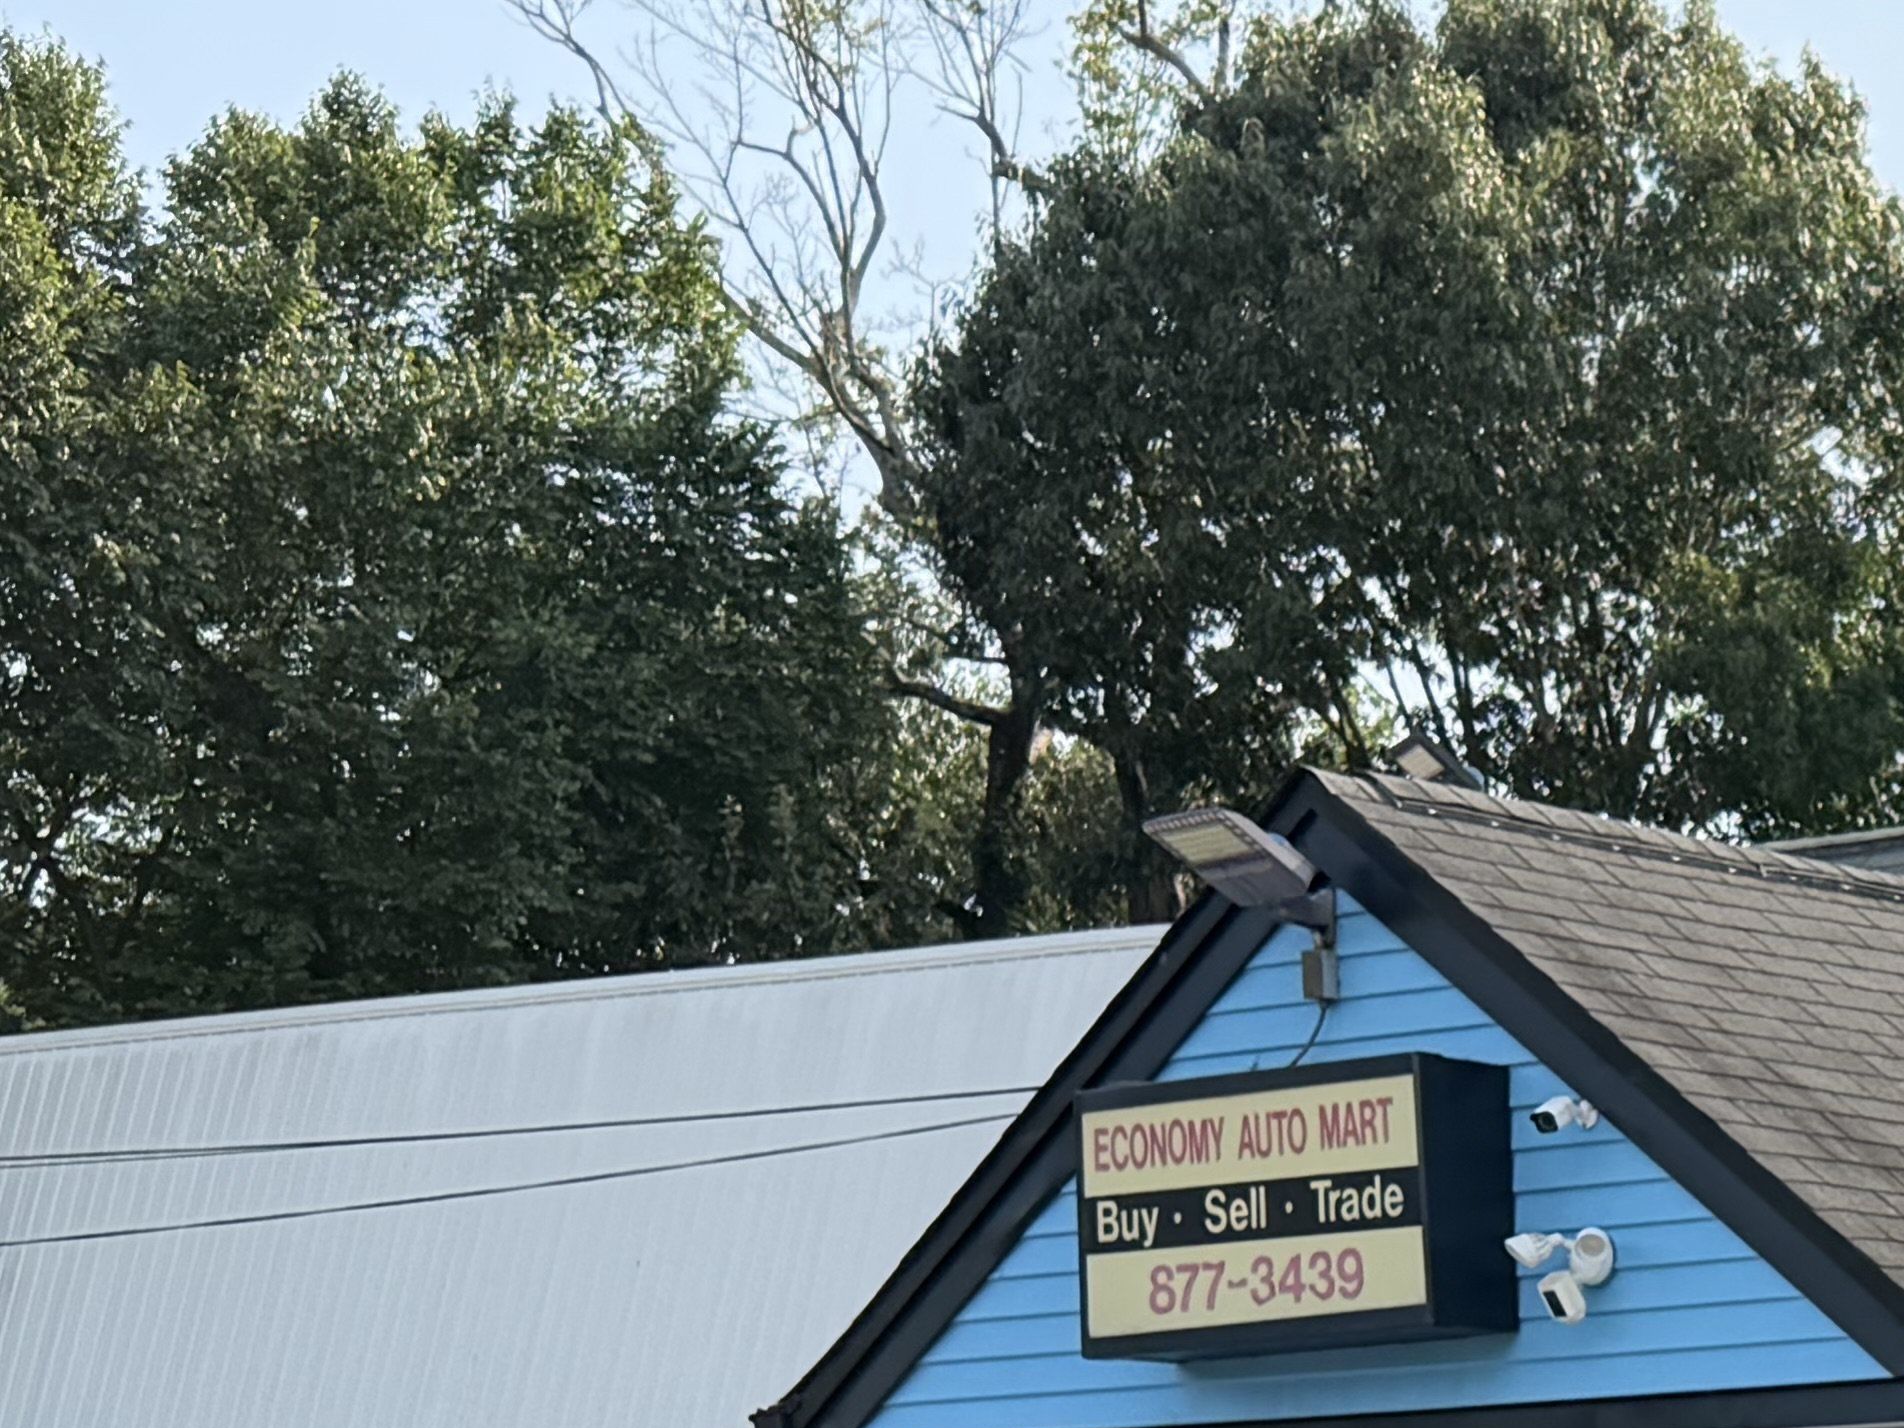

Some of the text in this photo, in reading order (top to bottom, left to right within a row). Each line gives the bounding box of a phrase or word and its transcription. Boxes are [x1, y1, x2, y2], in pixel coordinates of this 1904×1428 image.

[1094, 1097, 1393, 1173] ECONOMY AUTO MART
[1096, 1175, 1404, 1248] Buy Sell Trade
[1148, 1248, 1365, 1315] 877-3439
